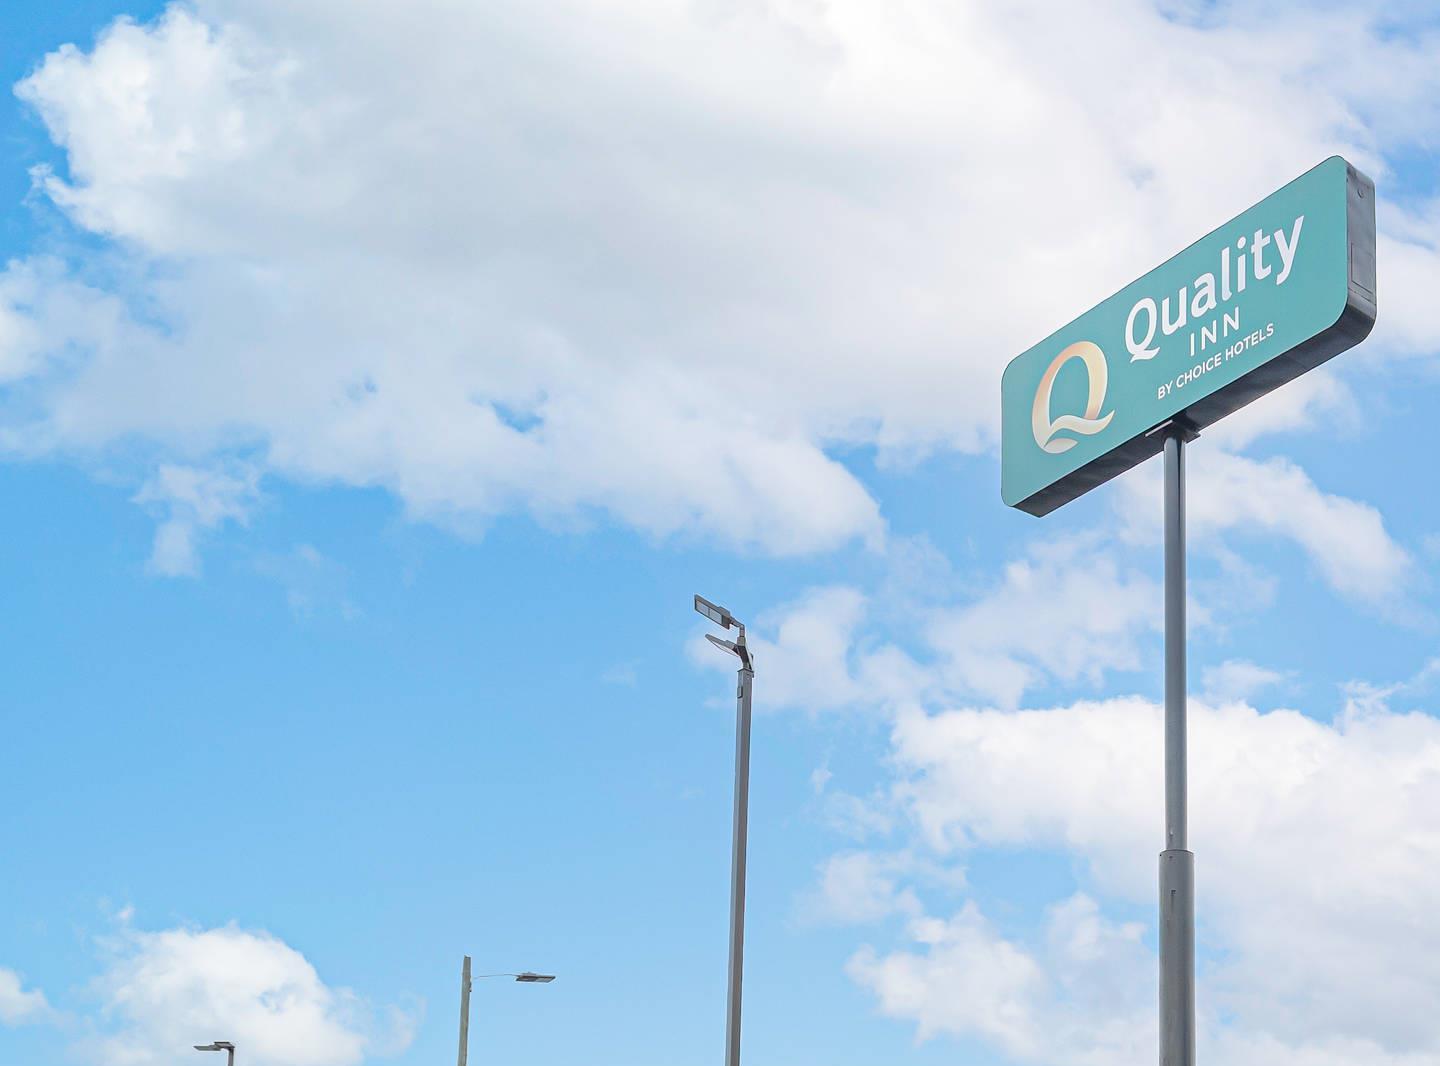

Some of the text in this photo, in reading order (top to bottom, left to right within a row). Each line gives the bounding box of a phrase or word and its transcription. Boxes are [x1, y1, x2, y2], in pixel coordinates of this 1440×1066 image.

[1125, 215, 1304, 363] Quality
[1190, 306, 1240, 357] INN
[1031, 340, 1116, 454] Q
[1158, 322, 1274, 400] BY CHOICE HOTELS
